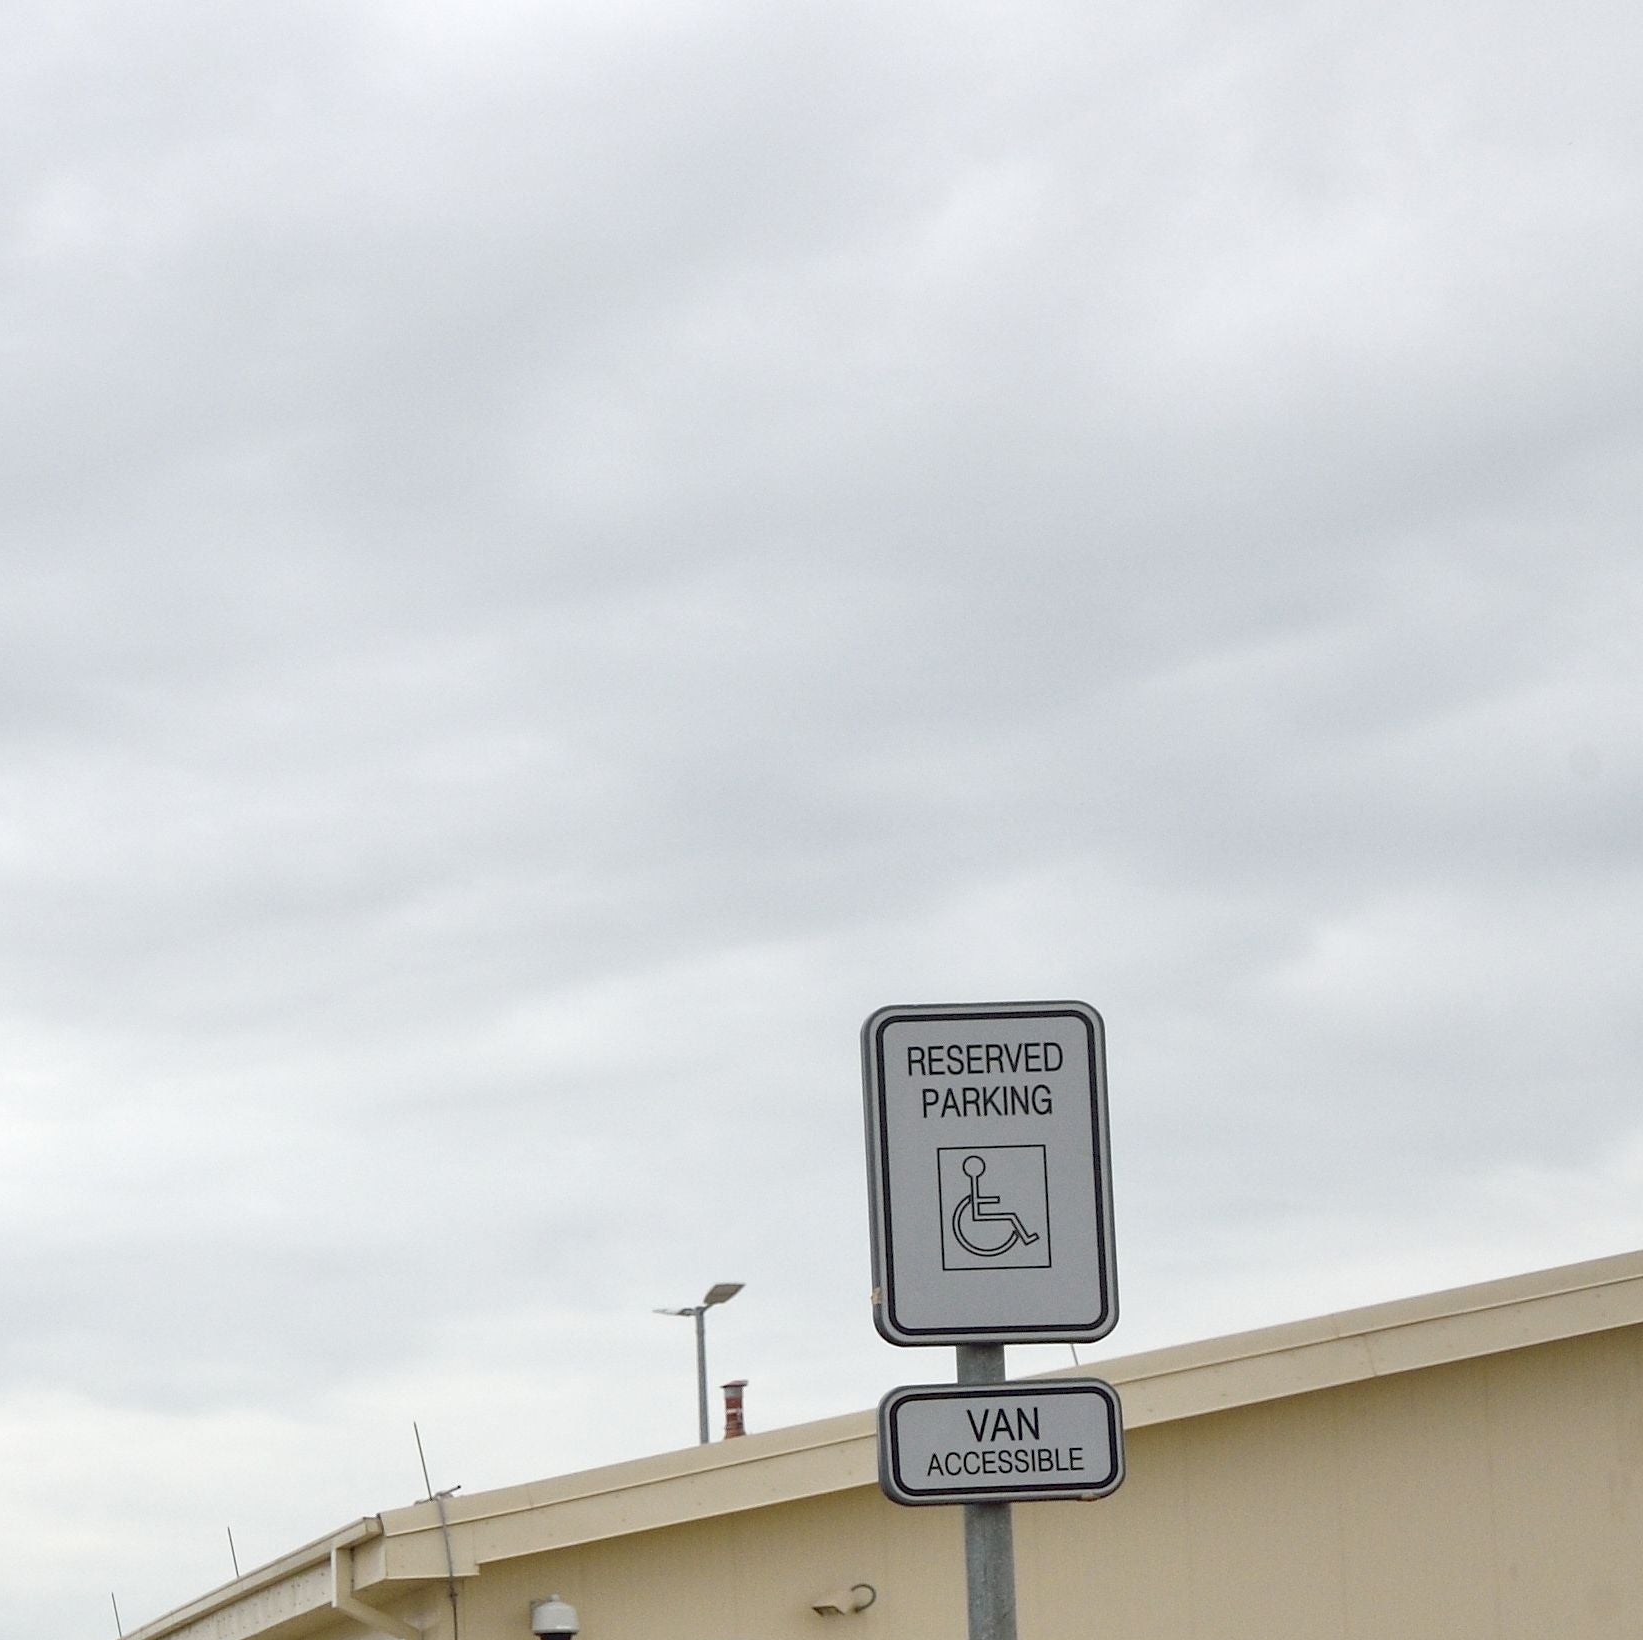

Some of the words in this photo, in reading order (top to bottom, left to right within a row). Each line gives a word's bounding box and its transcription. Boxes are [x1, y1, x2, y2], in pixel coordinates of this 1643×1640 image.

[907, 1042, 1064, 1077] RESERVED
[922, 1084, 1053, 1118] PARKING
[967, 1407, 1040, 1442] VAN
[927, 1447, 1084, 1476] ACCESSIBLE
